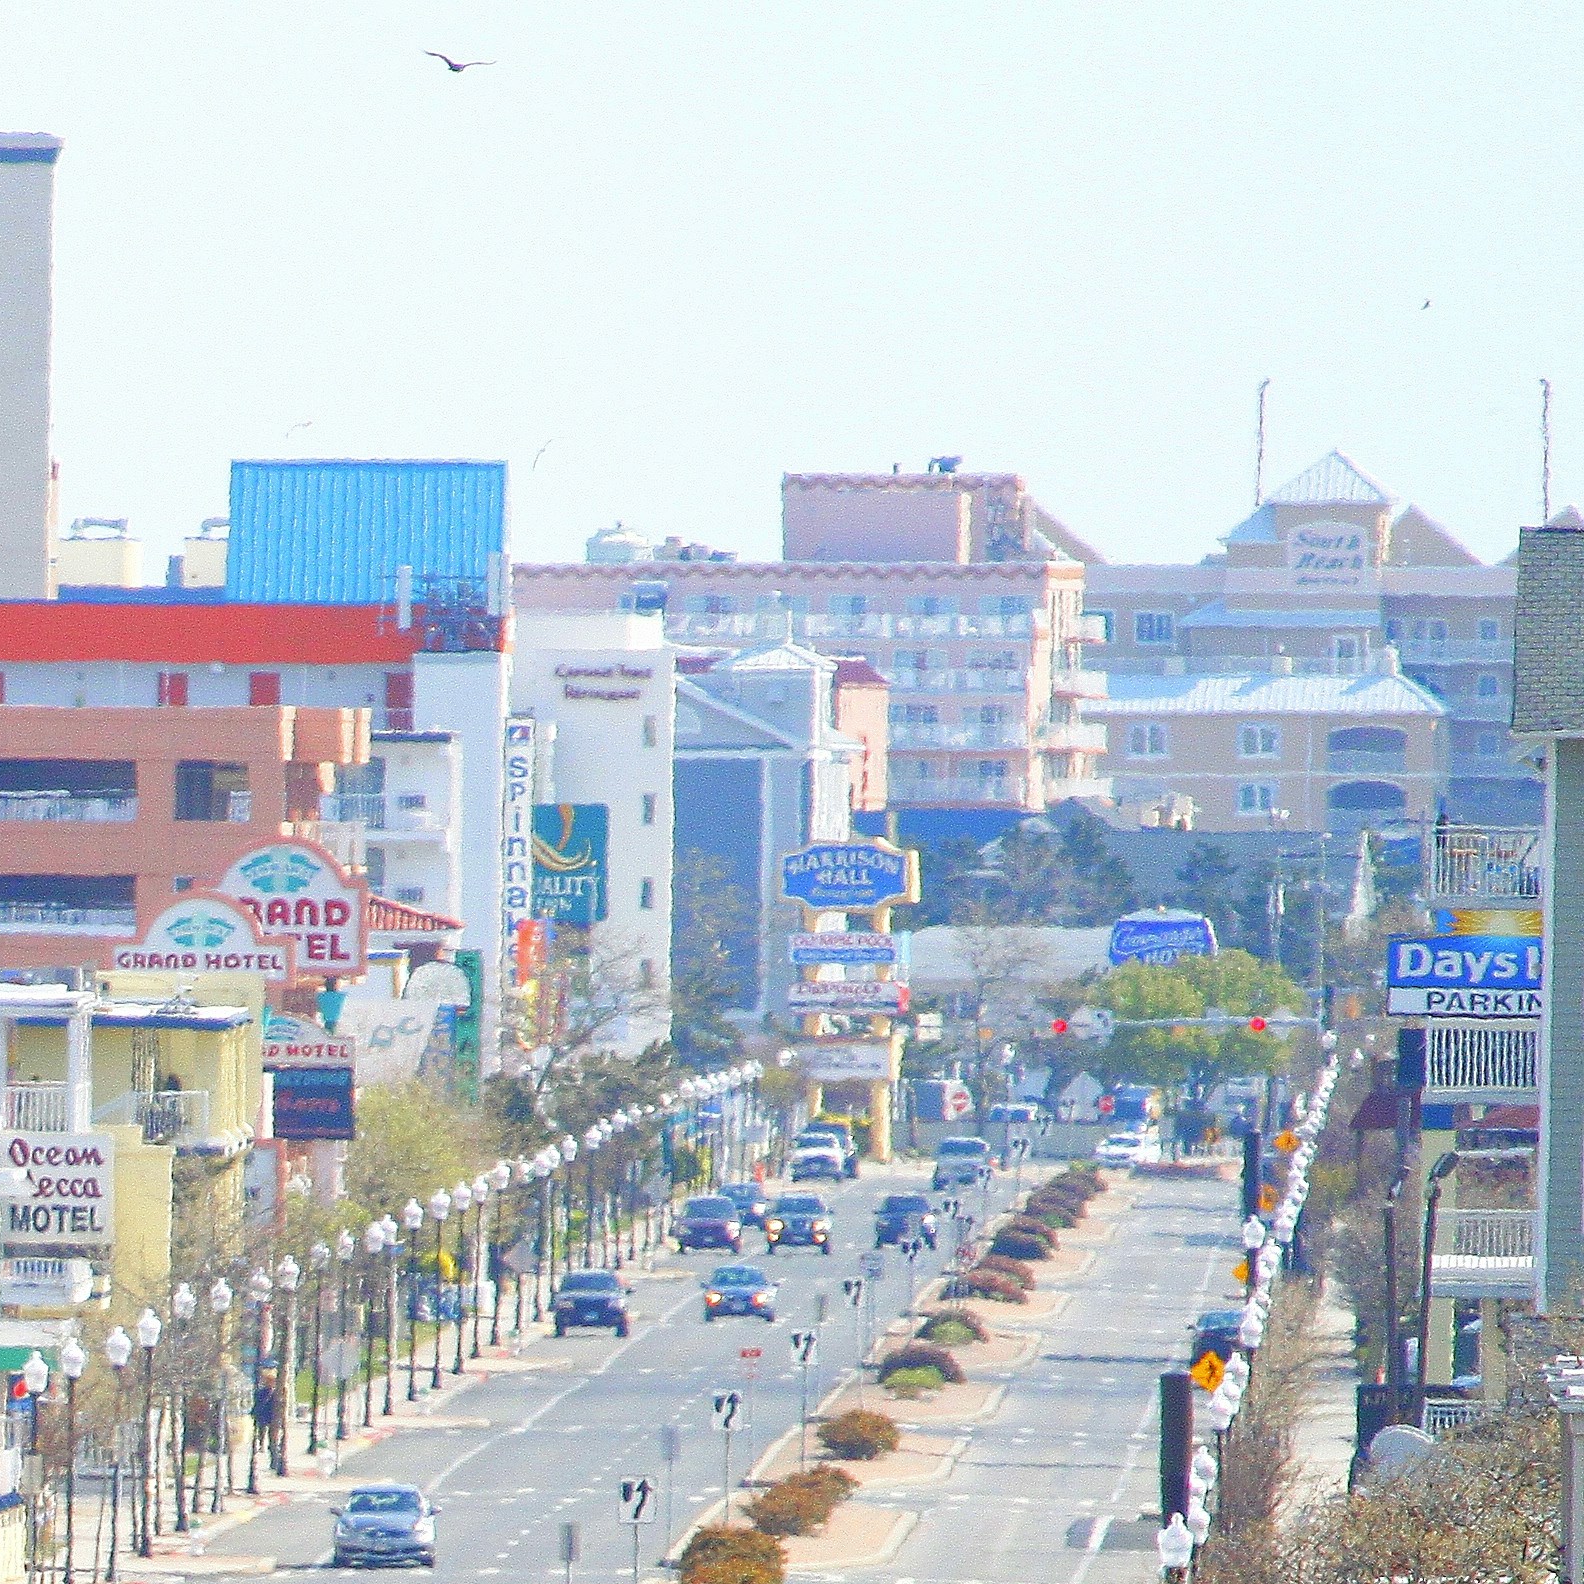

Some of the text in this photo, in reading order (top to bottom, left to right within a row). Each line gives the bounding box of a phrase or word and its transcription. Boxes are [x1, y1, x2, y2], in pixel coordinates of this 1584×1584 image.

[205, 953, 285, 970] HOTEL
[1397, 942, 1519, 983] Days
[9, 1138, 106, 1167] Ocean
[26, 1168, 104, 1198] ecca
[10, 1204, 104, 1233] MOTEL
